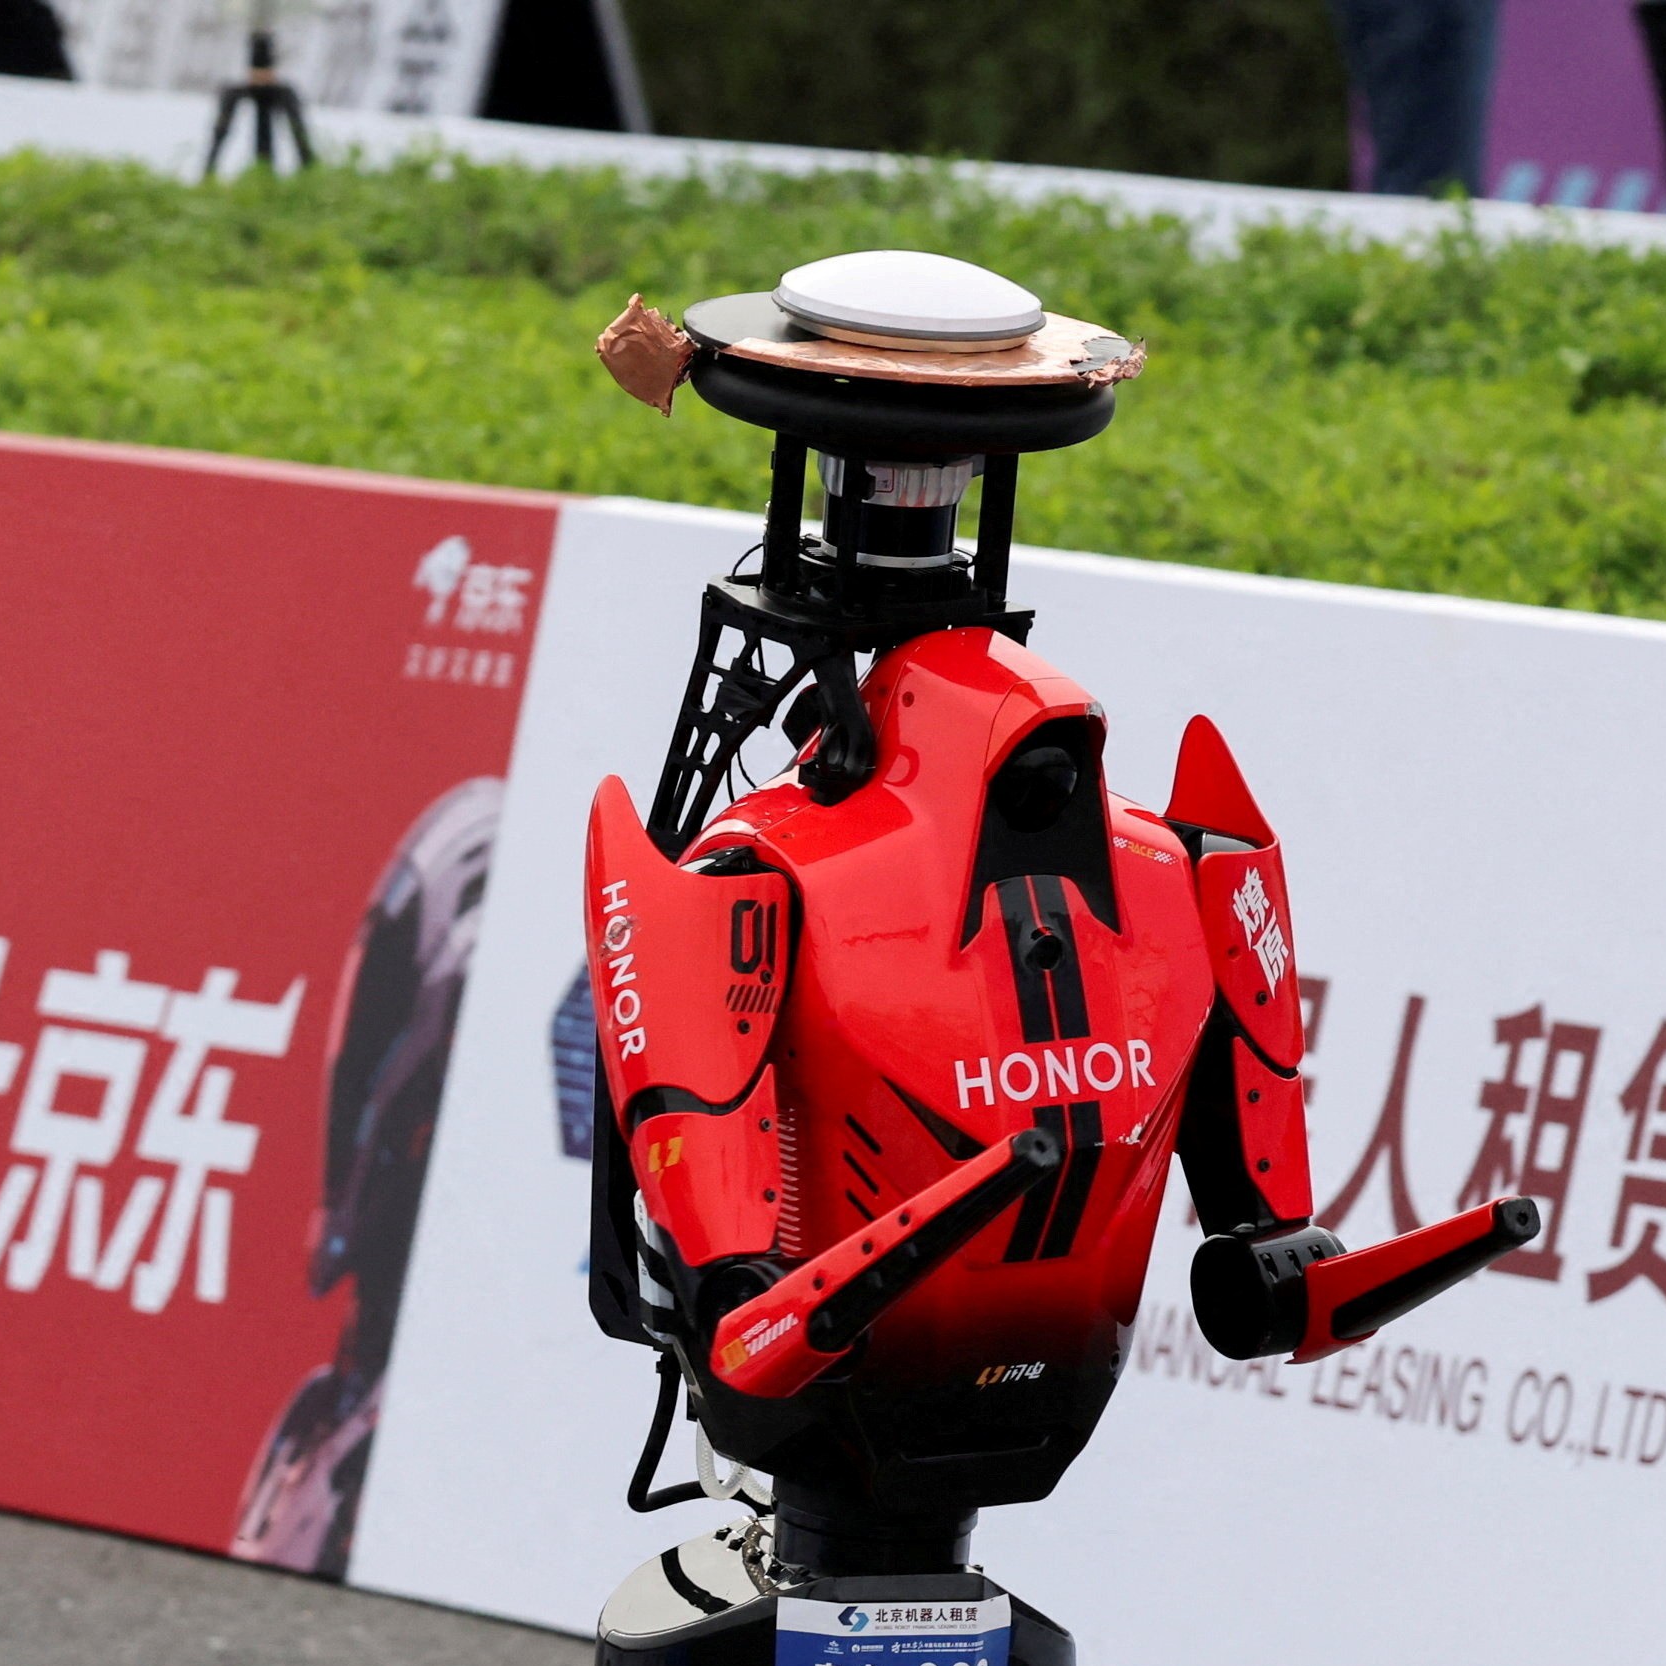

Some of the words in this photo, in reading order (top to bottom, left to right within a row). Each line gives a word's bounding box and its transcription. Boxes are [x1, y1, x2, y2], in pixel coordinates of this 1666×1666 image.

[1127, 841, 1155, 859] RACE
[601, 879, 647, 1061] HONOR
[954, 1038, 1156, 1109] HONOR
[1001, 1361, 1046, 1383] 闪电
[1311, 1341, 1488, 1433] LEASING
[875, 1607, 978, 1623] 北京机器人租赁
